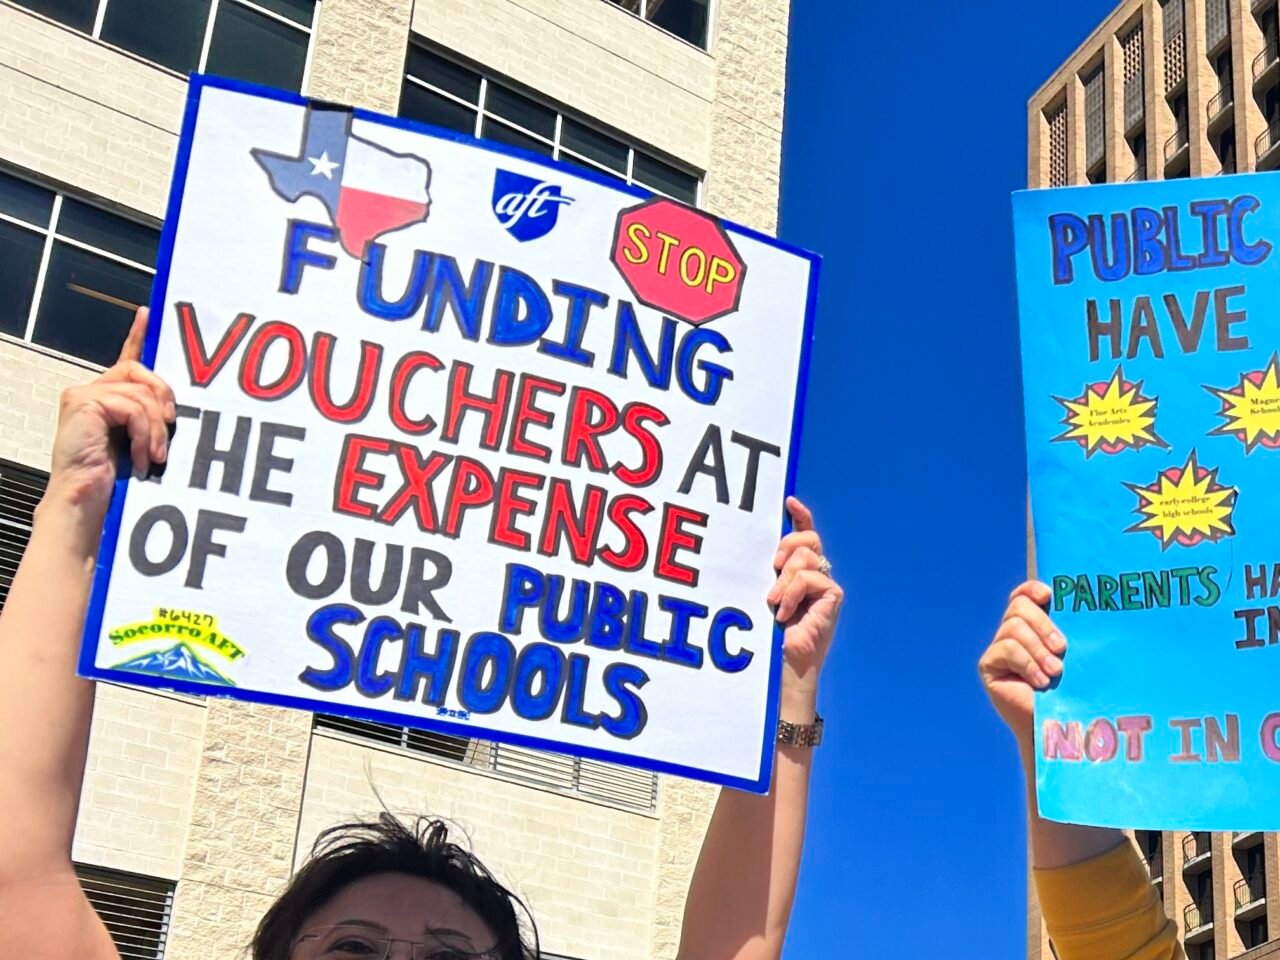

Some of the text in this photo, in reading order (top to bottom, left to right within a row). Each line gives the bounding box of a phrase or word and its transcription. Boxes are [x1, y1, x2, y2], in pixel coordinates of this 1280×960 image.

[622, 222, 737, 295] STOP
[1048, 195, 1273, 286] PUBLIC
[279, 217, 734, 406] FUNDING
[1086, 284, 1251, 363] HAVE
[176, 301, 781, 512] VOUCHERS AT
[1089, 407, 1128, 418] Fine Arts
[333, 435, 709, 587] EXPENSE
[1162, 507, 1214, 519] high schools
[128, 505, 753, 673] OF OUR PUBLIC
[158, 608, 214, 627] #6427
[1052, 565, 1221, 612] PARENTS
[108, 620, 245, 663] Socorro AFT
[300, 602, 649, 740] SCHOOLS
[1043, 715, 1152, 763] NOT
[1169, 713, 1240, 763] IN
